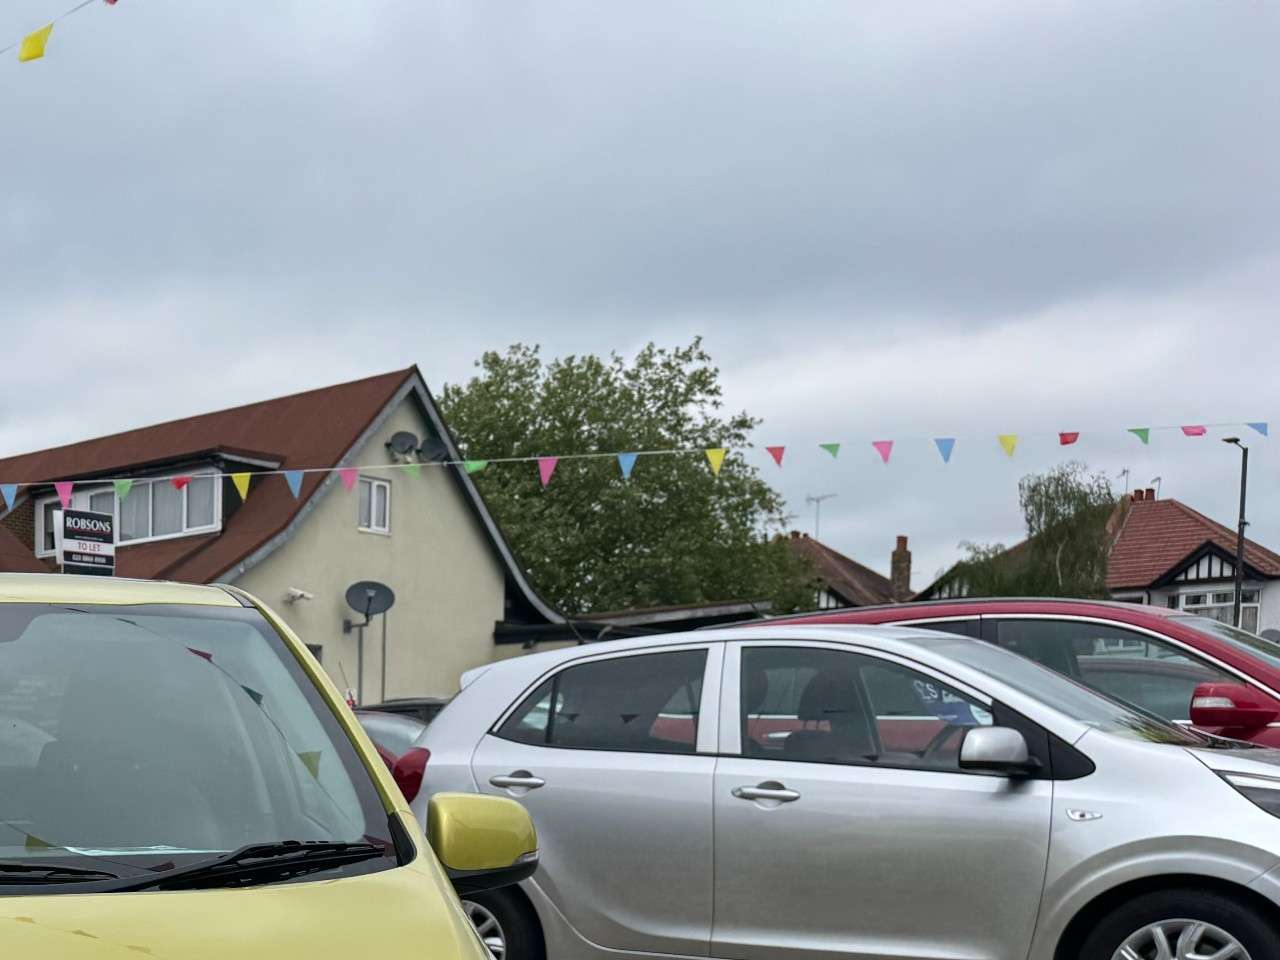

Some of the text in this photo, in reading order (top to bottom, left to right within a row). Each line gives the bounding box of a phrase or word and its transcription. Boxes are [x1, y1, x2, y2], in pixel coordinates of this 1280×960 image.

[65, 516, 111, 532] ROBSONS
[78, 542, 101, 551] TO LET
